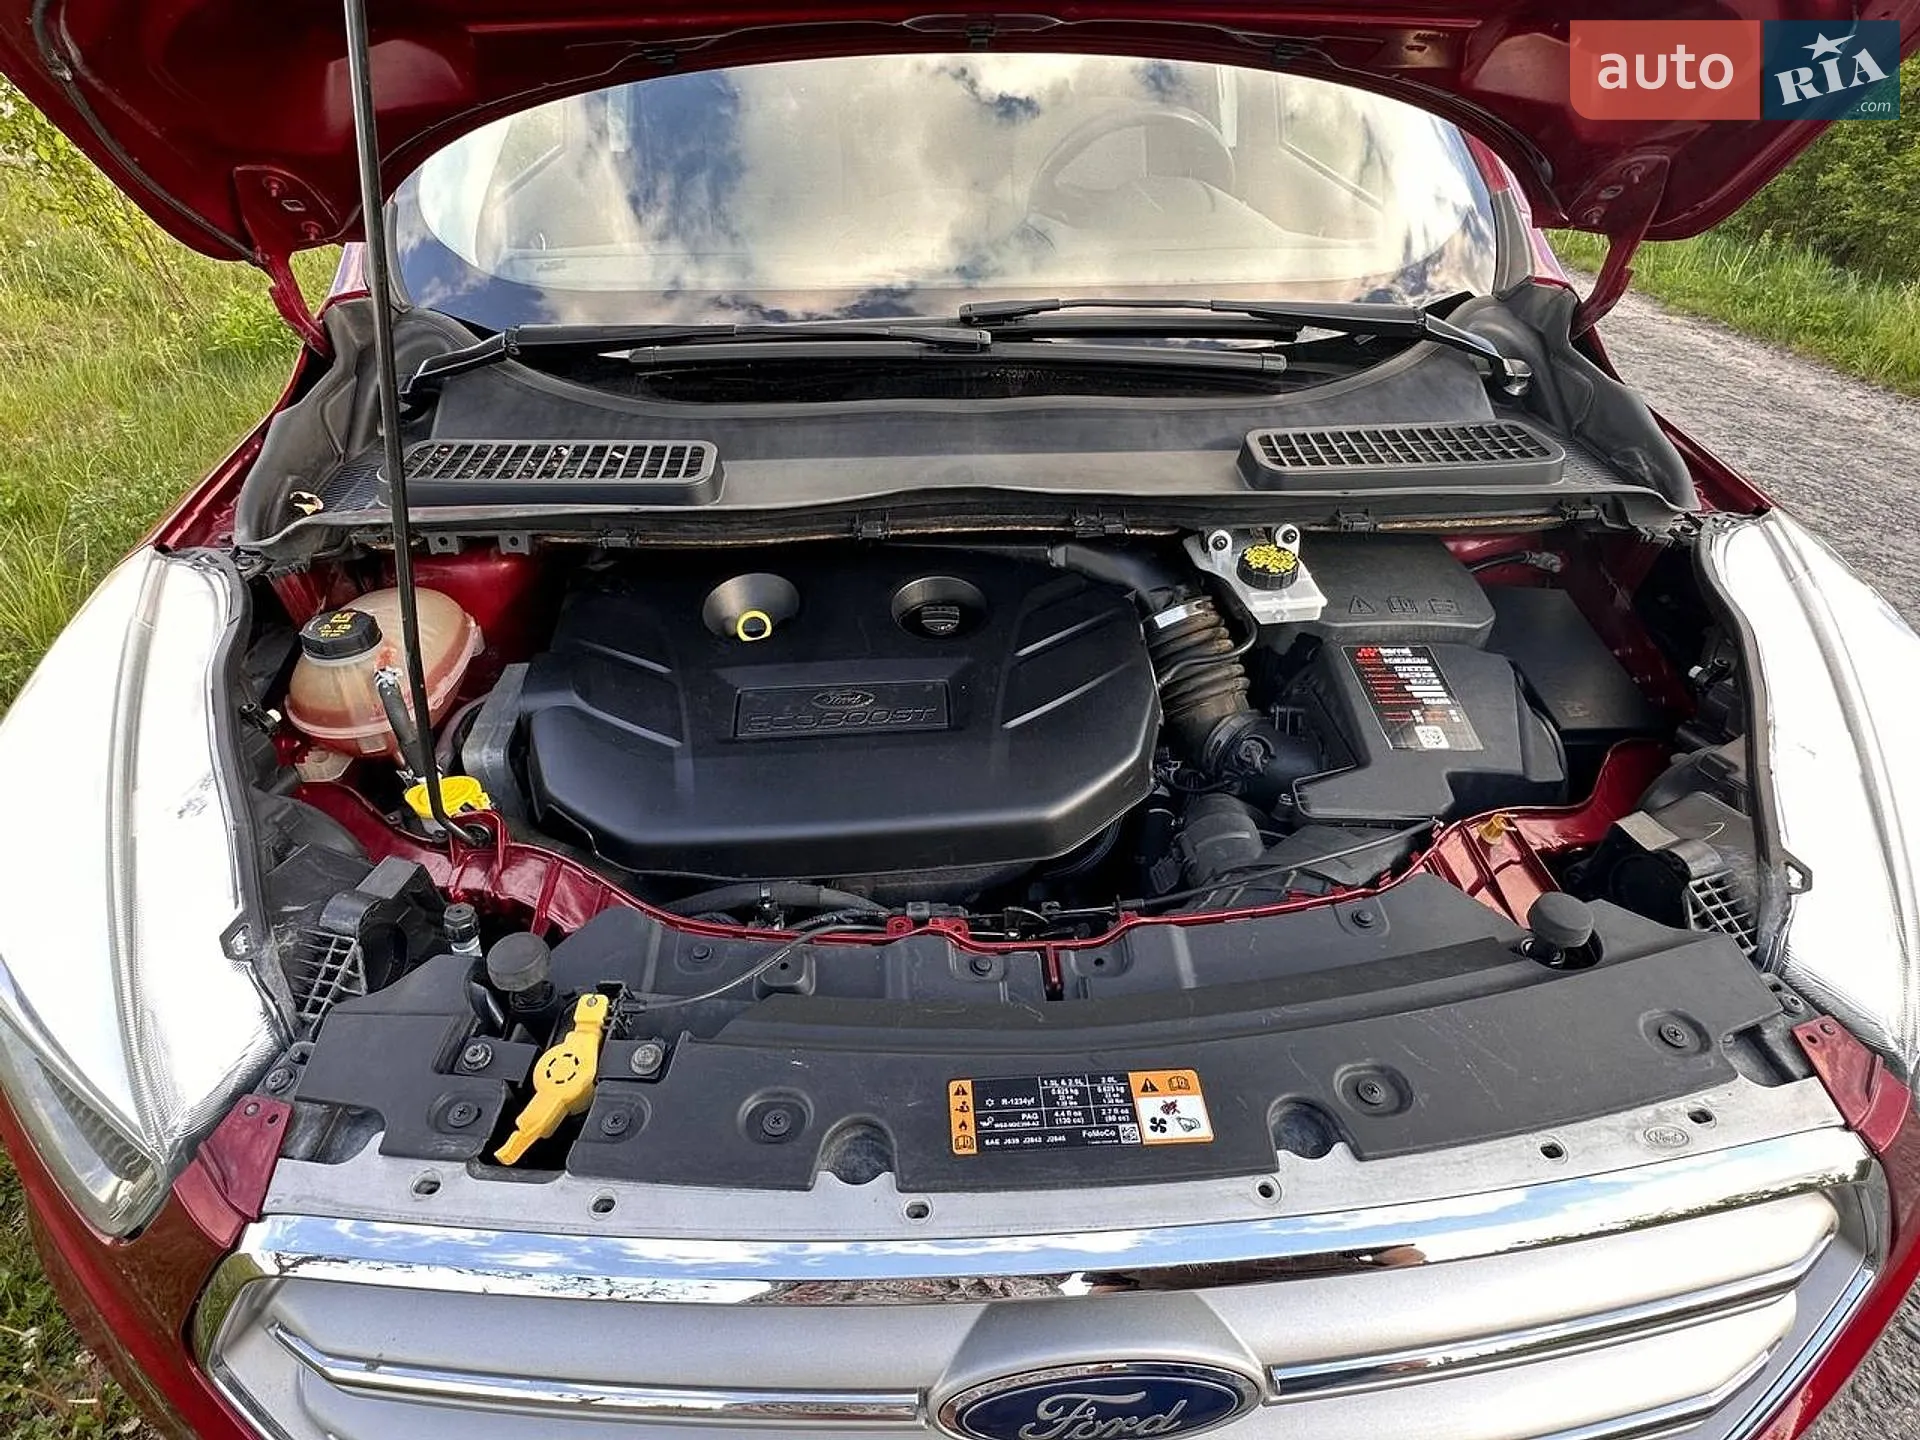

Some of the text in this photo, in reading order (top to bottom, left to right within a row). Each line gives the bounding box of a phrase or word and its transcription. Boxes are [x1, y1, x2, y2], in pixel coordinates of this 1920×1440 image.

[747, 708, 937, 732] ECOBOOST
[1021, 1112, 1039, 1120] PAG
[1081, 1129, 1116, 1138] FoMoCo
[1018, 1390, 1188, 1440] Ford
